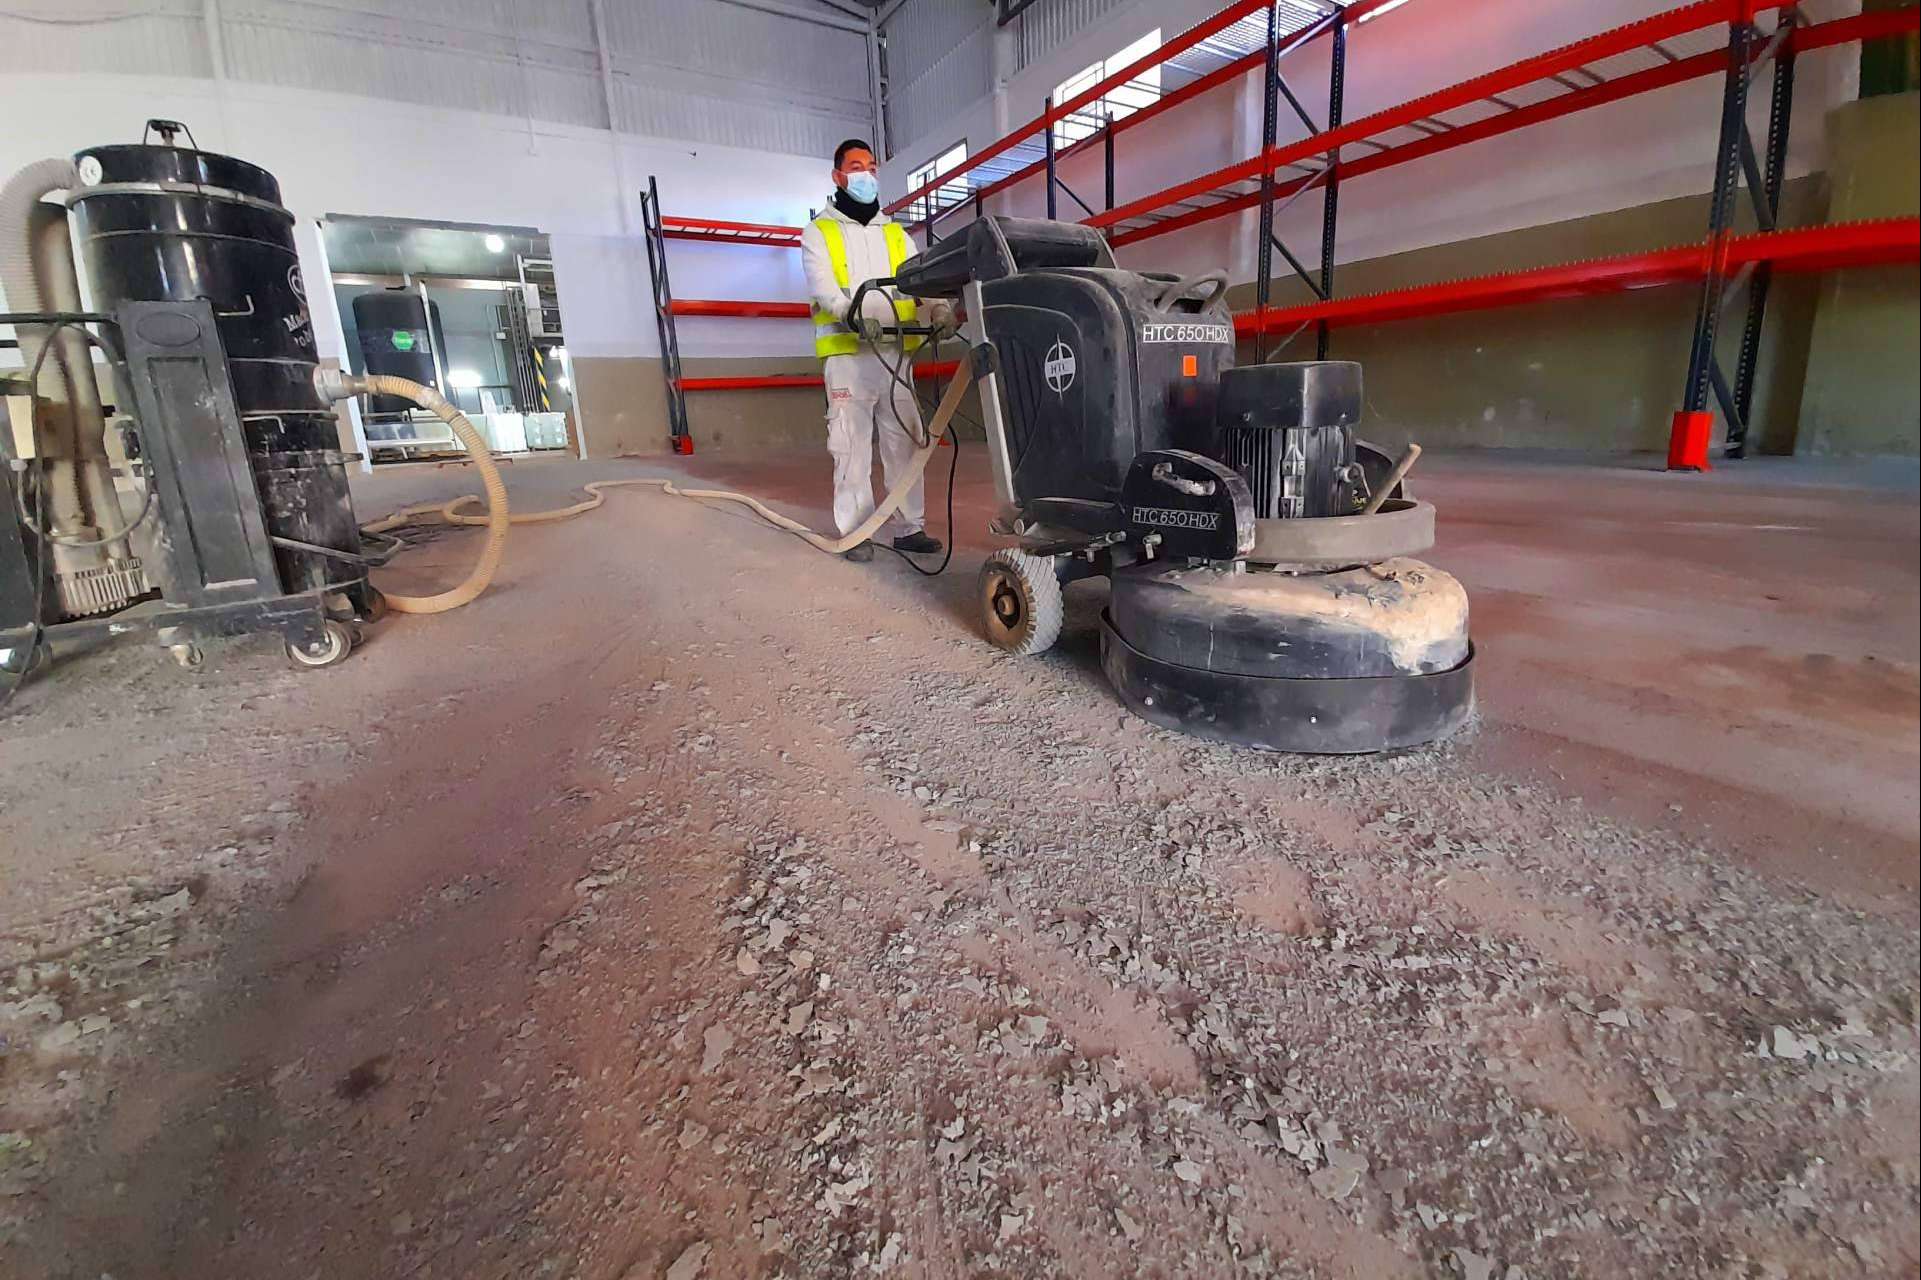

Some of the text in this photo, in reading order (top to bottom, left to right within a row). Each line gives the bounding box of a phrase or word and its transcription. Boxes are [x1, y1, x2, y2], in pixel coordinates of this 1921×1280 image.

[1143, 325, 1229, 342] HTC 650 HDX
[1133, 507, 1219, 529] HTC 650 HDX
